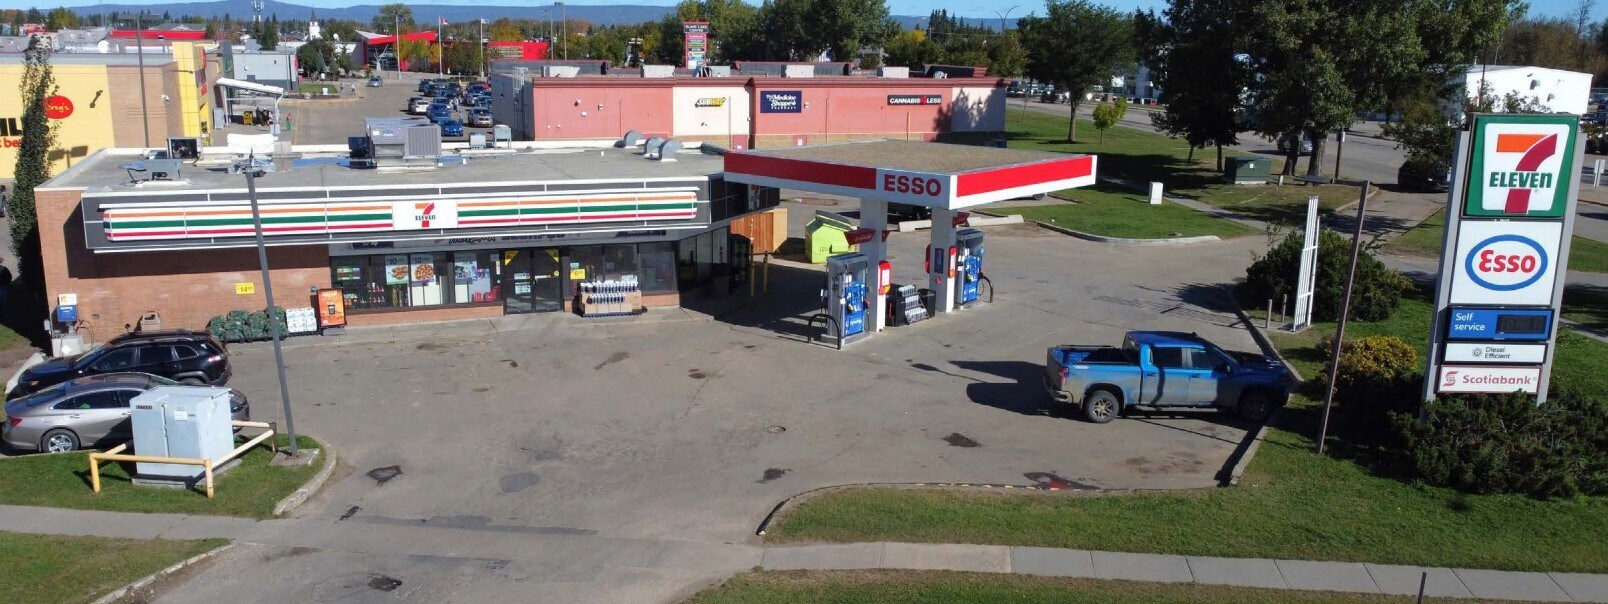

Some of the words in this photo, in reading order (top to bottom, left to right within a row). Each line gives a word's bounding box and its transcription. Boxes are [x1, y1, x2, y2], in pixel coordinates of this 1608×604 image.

[884, 174, 942, 196] ESSO
[1496, 134, 1558, 214] 7
[415, 202, 434, 228] 7
[1478, 250, 1536, 274] Esso
[1462, 374, 1531, 384] Scotiabank
